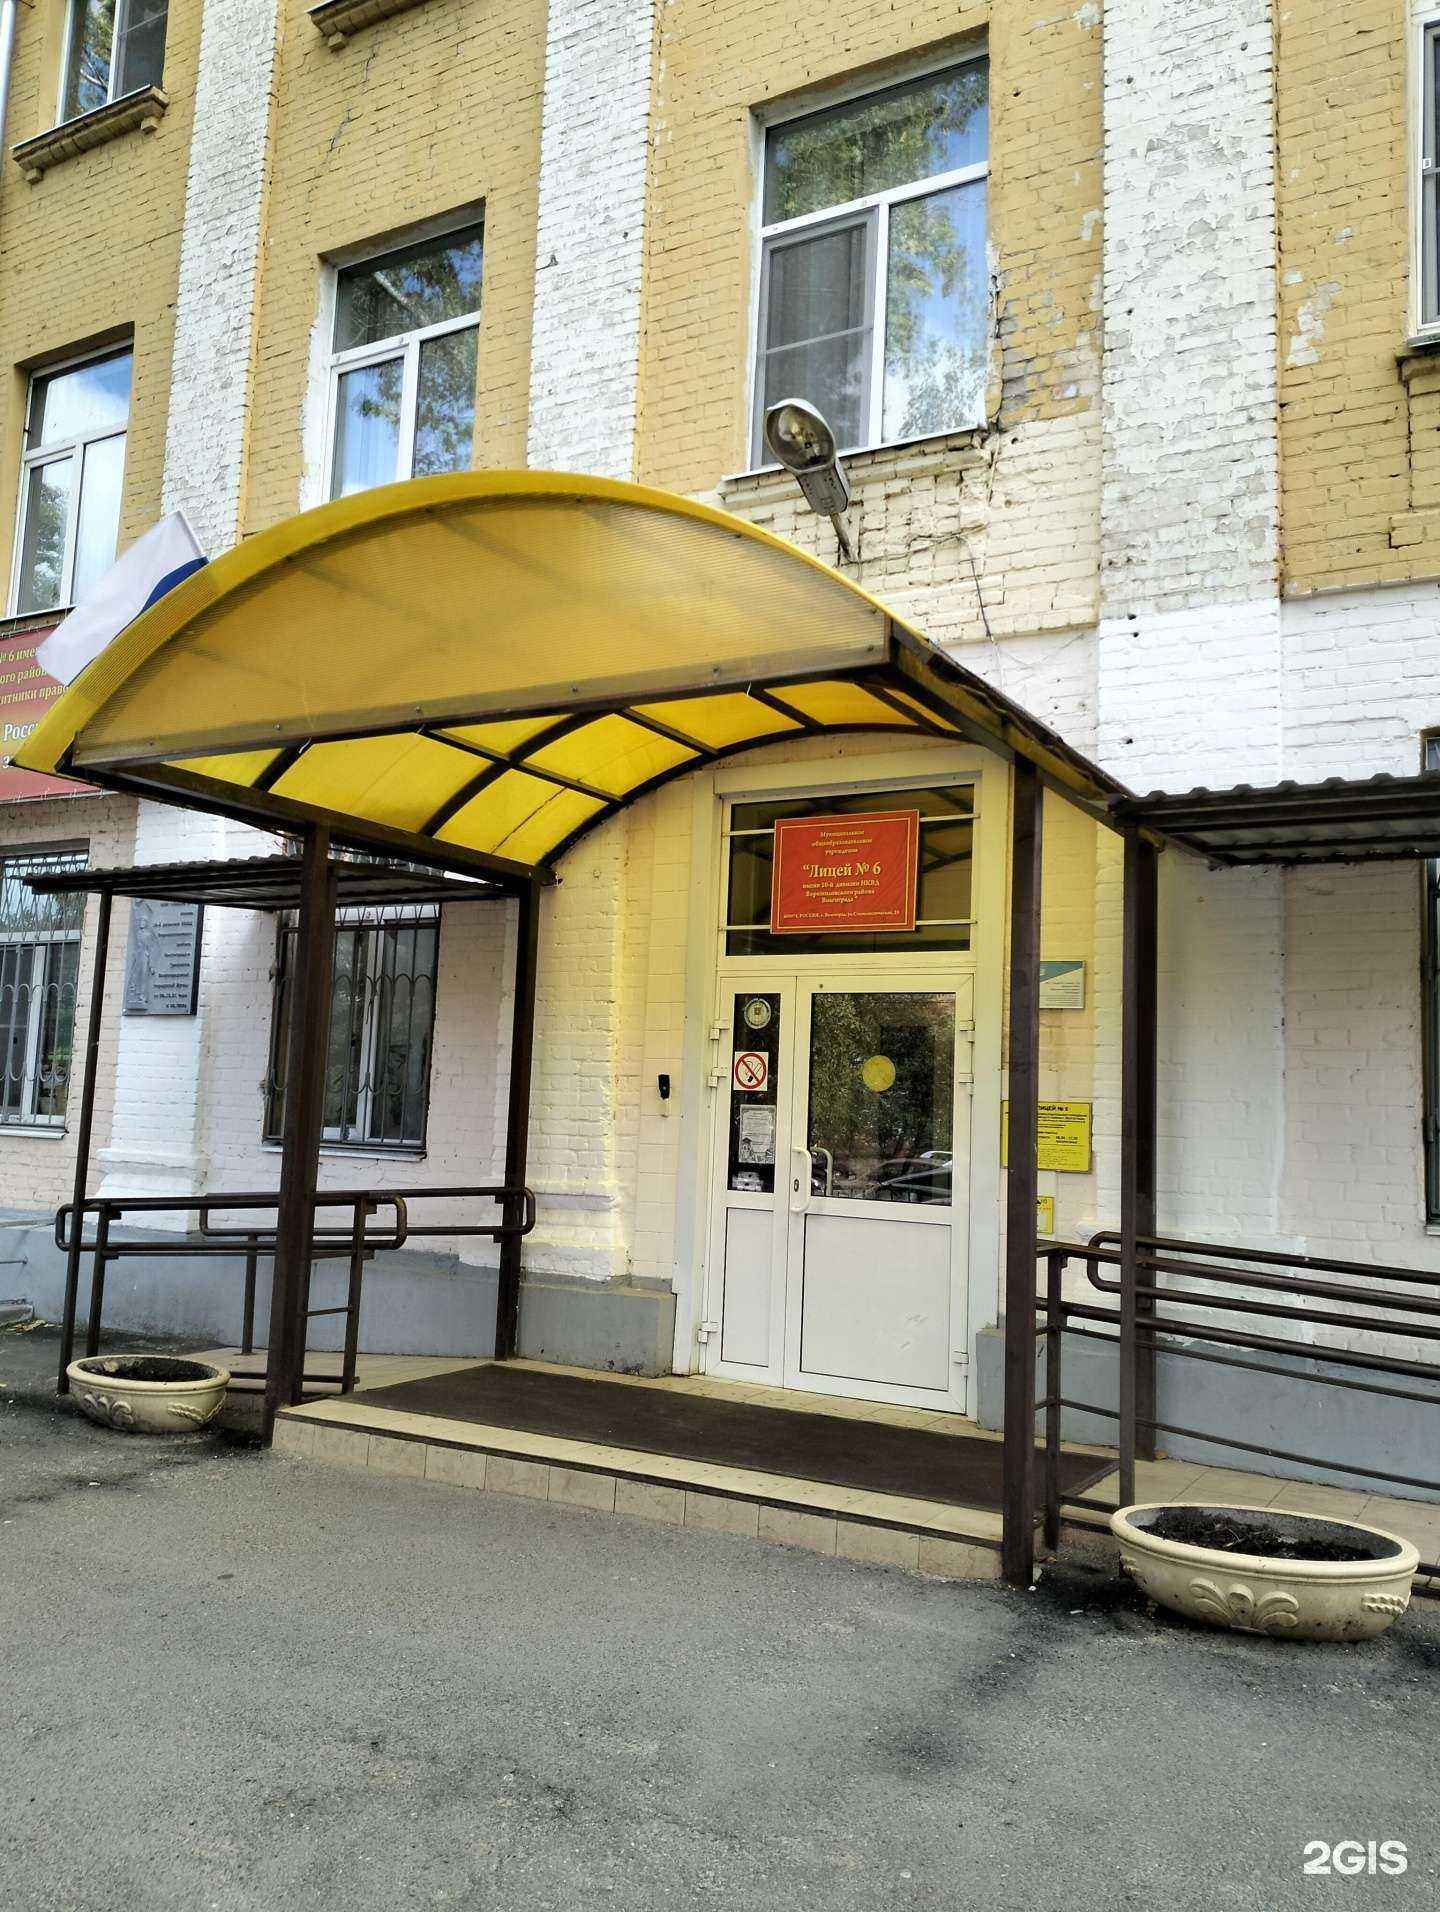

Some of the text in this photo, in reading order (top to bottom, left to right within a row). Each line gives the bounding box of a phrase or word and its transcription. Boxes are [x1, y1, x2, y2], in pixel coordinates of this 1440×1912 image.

[8, 649, 15, 662] 6
[3, 722, 40, 742] Росс
[855, 861, 870, 876] №
[872, 861, 881, 875] 6
